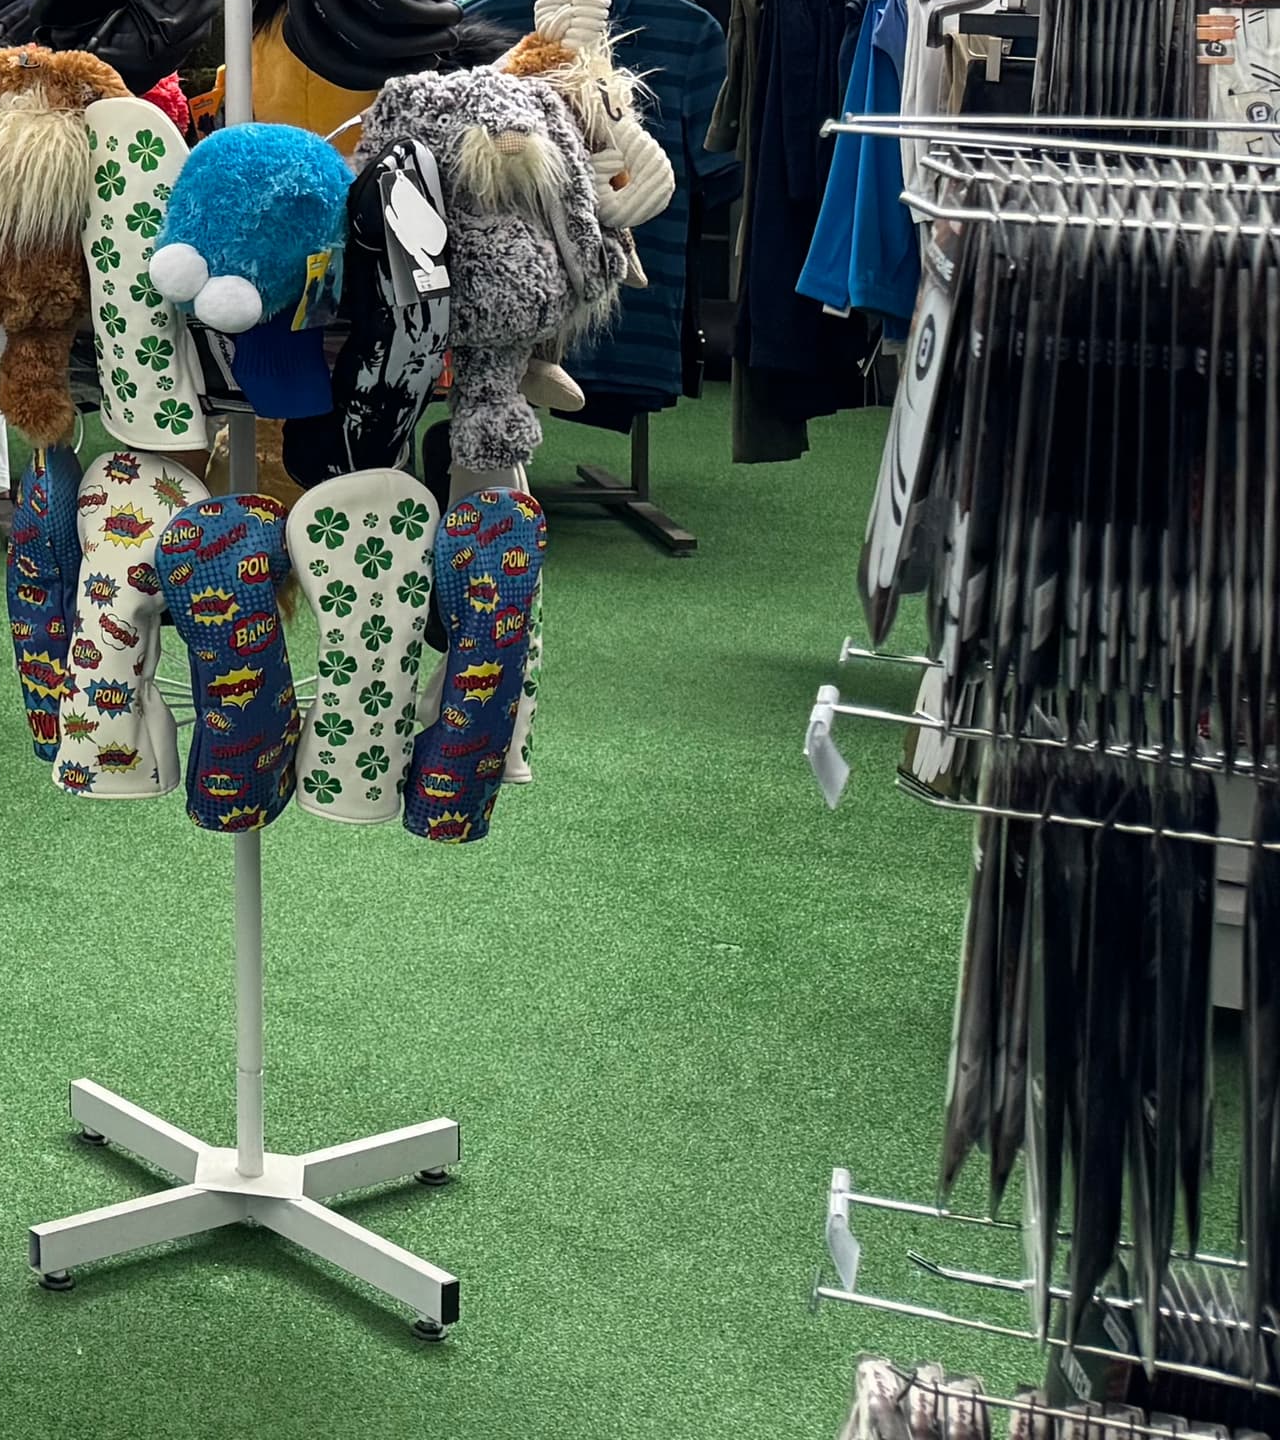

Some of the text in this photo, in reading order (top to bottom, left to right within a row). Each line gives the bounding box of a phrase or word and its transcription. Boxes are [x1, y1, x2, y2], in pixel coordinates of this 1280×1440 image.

[446, 510, 482, 529] BANG!
[162, 525, 201, 546] BANG!
[451, 546, 475, 571] POW!
[501, 551, 531, 570] POW!
[169, 562, 193, 586] POW!
[91, 580, 116, 598] POW!
[235, 614, 278, 648] BANG!
[94, 688, 128, 706] POW!
[206, 711, 232, 731] POW!
[444, 707, 470, 729] POW!
[62, 770, 90, 786] POW!
